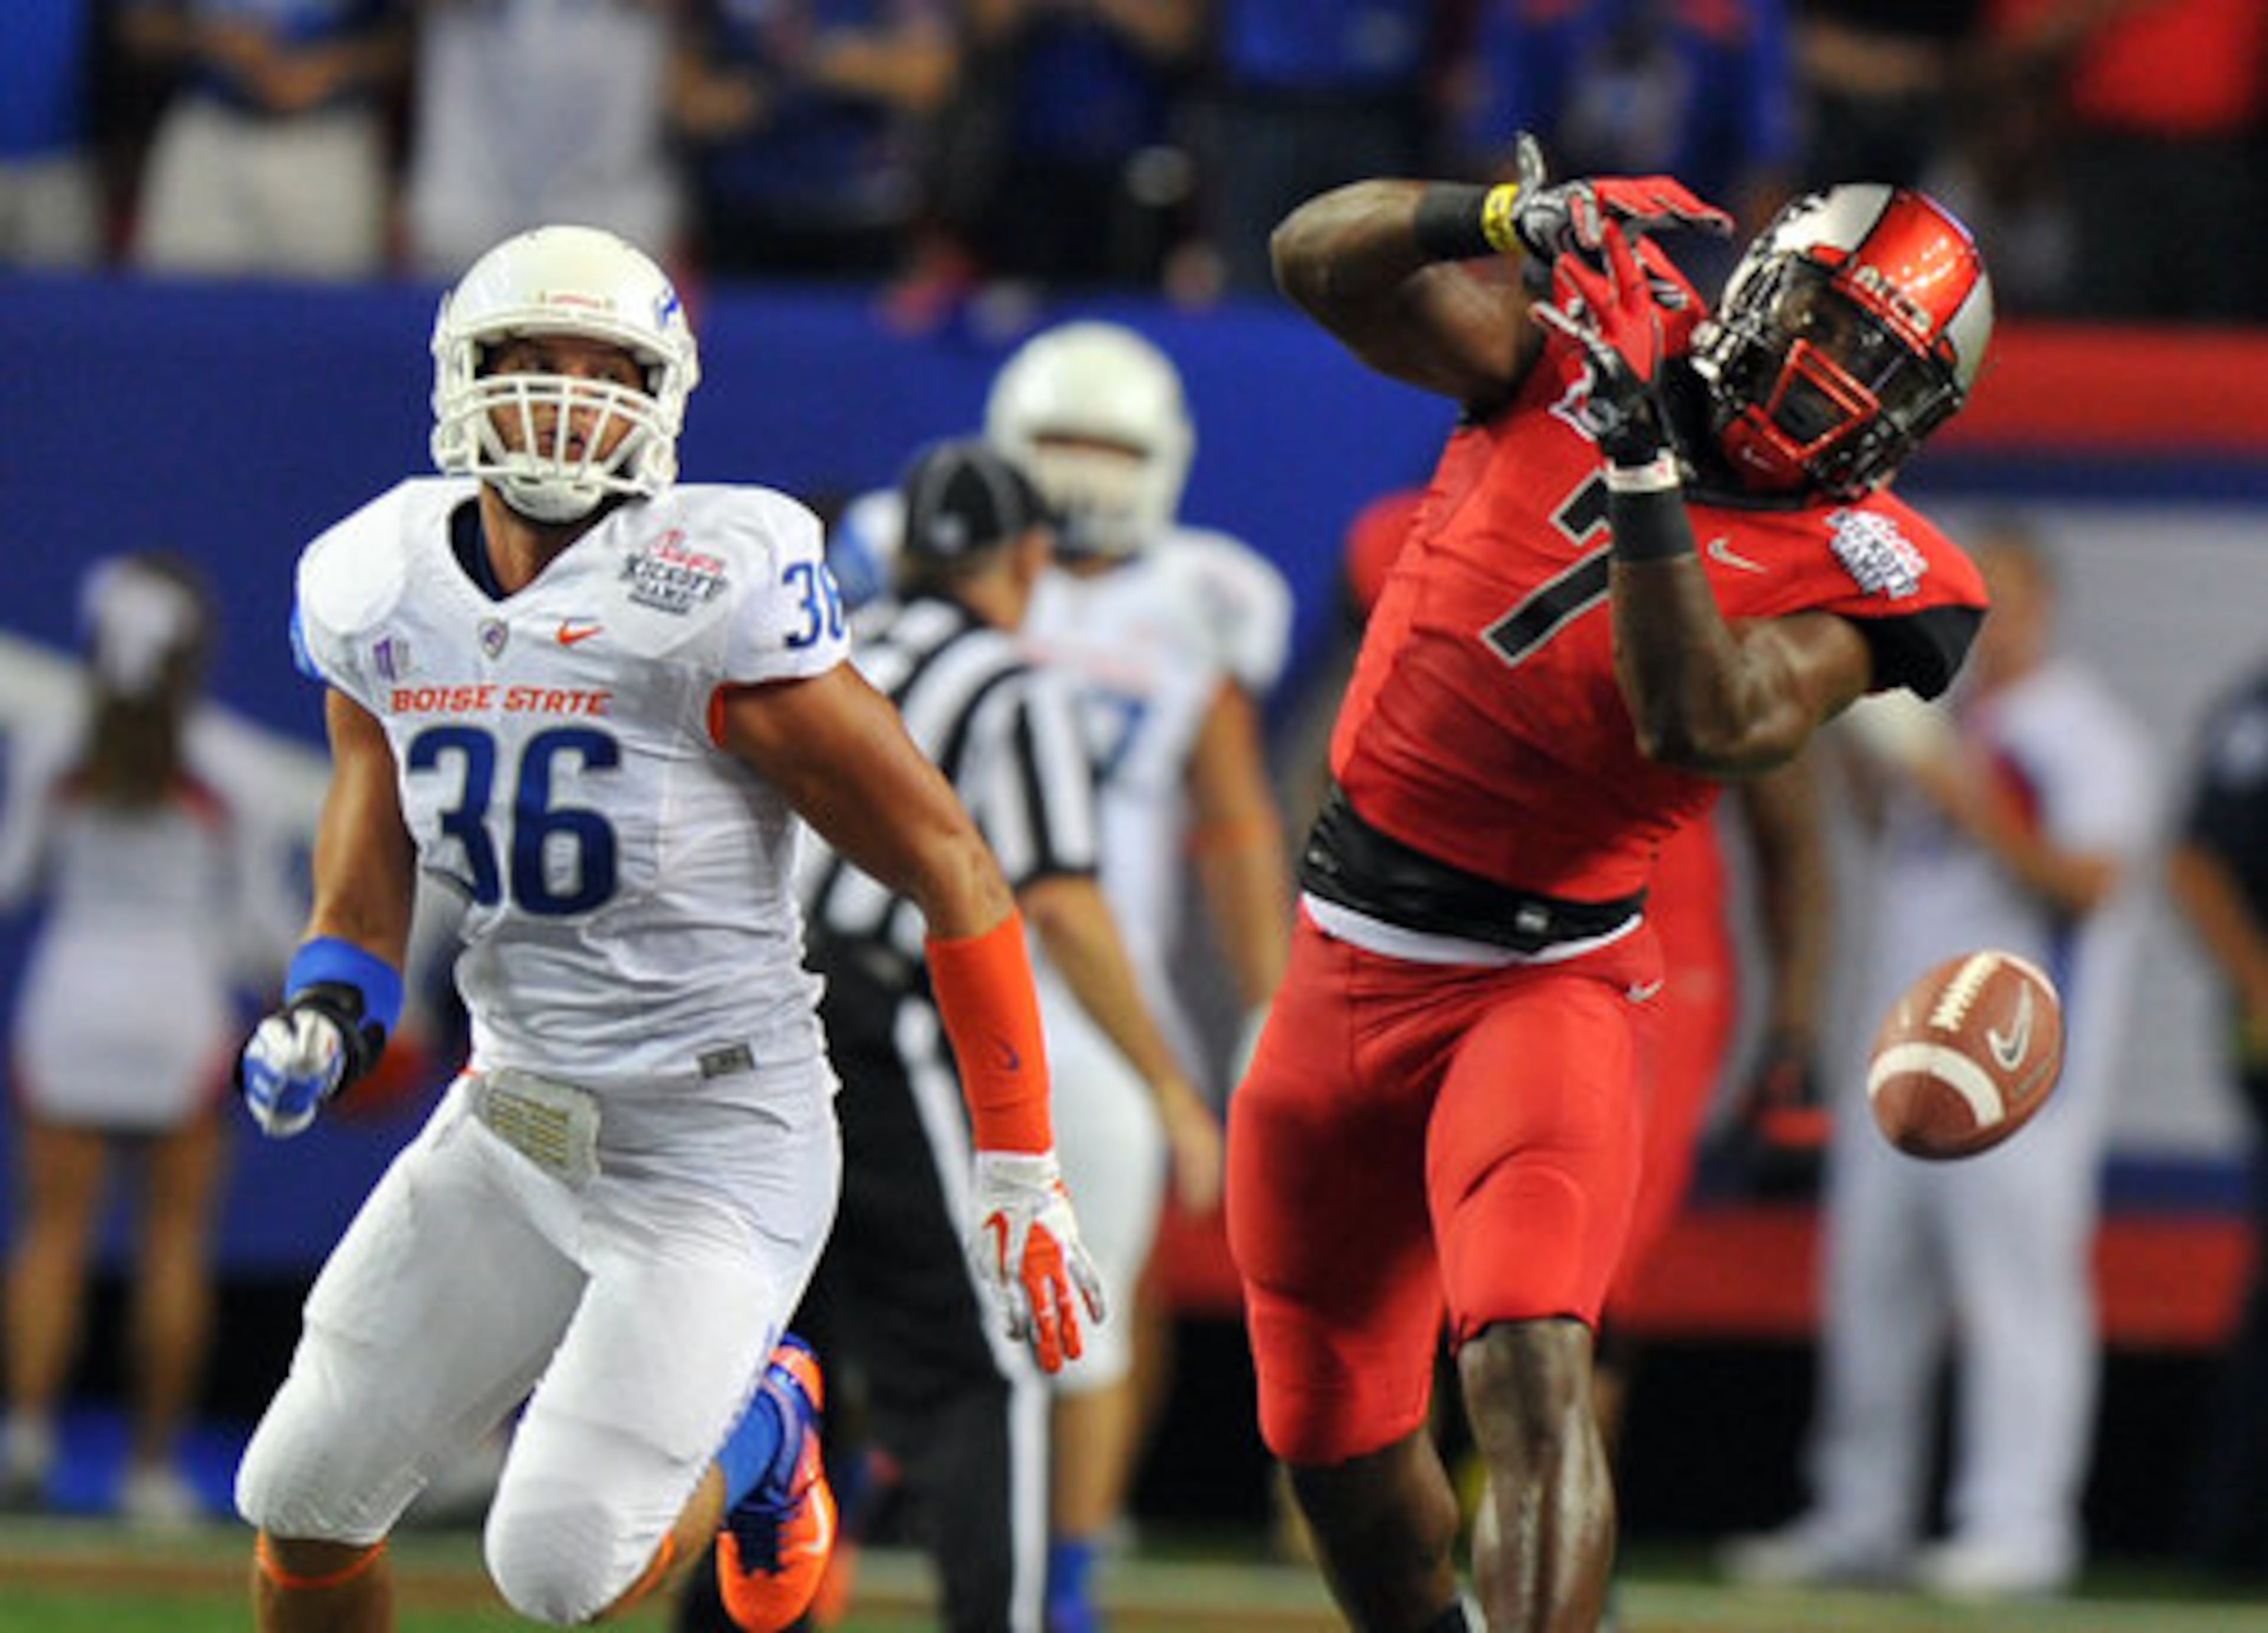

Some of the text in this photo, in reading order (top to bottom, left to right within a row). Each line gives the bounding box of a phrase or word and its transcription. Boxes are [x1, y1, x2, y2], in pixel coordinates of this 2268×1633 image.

[391, 685, 614, 716] BOISE STATE
[406, 725, 621, 917] 36
